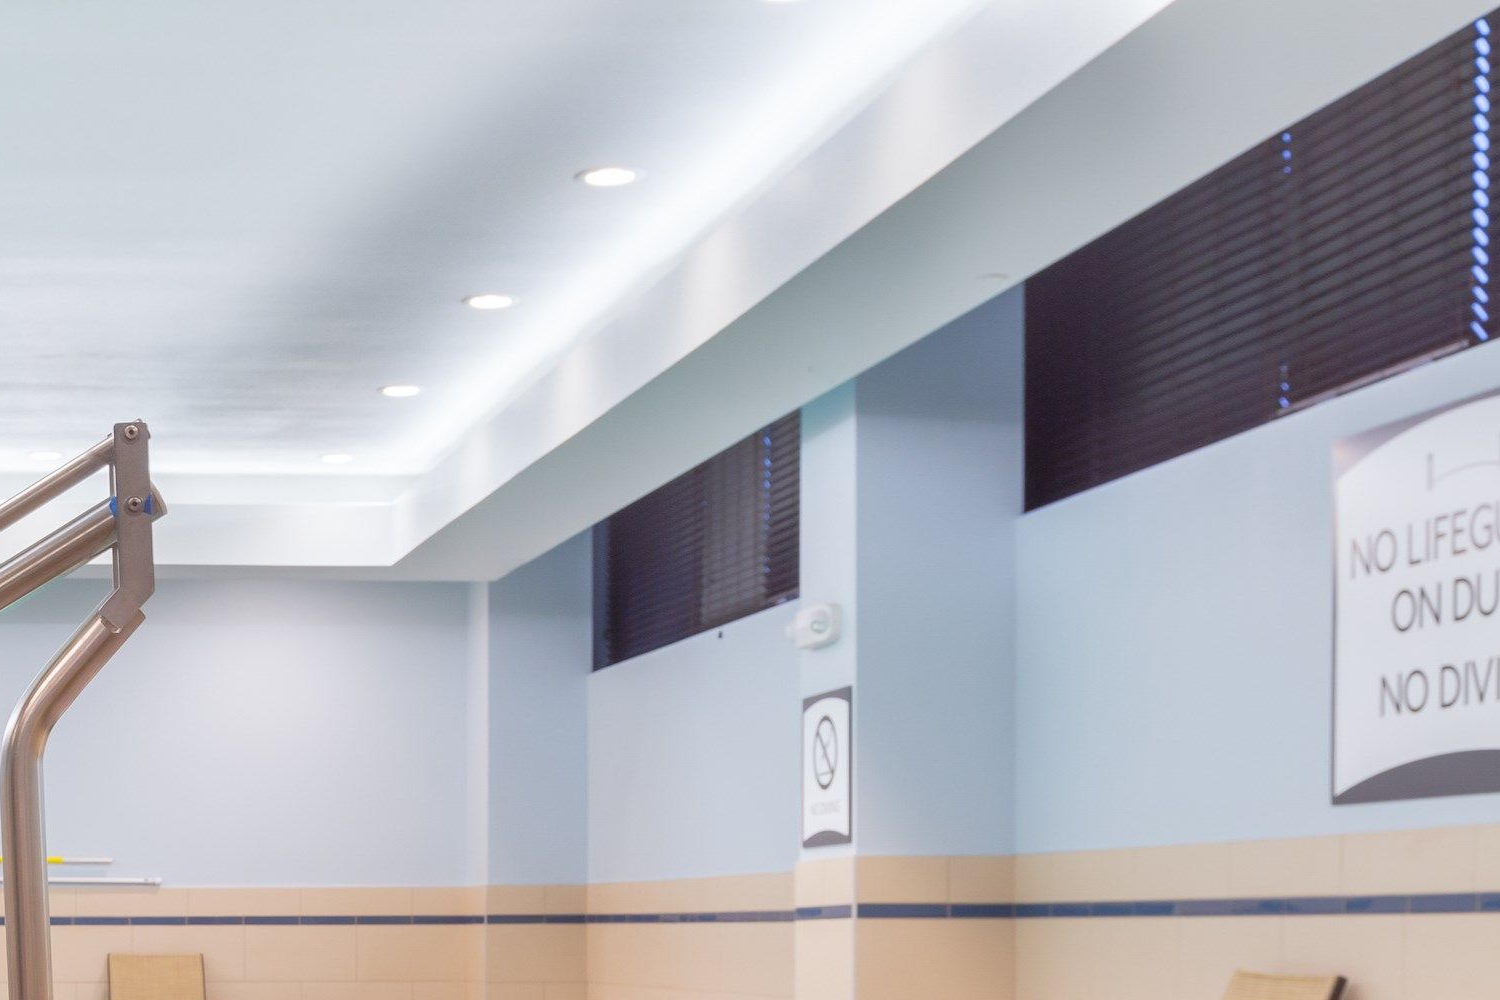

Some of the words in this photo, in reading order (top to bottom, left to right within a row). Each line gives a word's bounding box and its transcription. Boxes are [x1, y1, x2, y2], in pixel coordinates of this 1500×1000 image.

[1349, 527, 1398, 580] NO
[1391, 584, 1442, 634] ON
[1452, 571, 1500, 623] DU
[1378, 669, 1429, 718] NO
